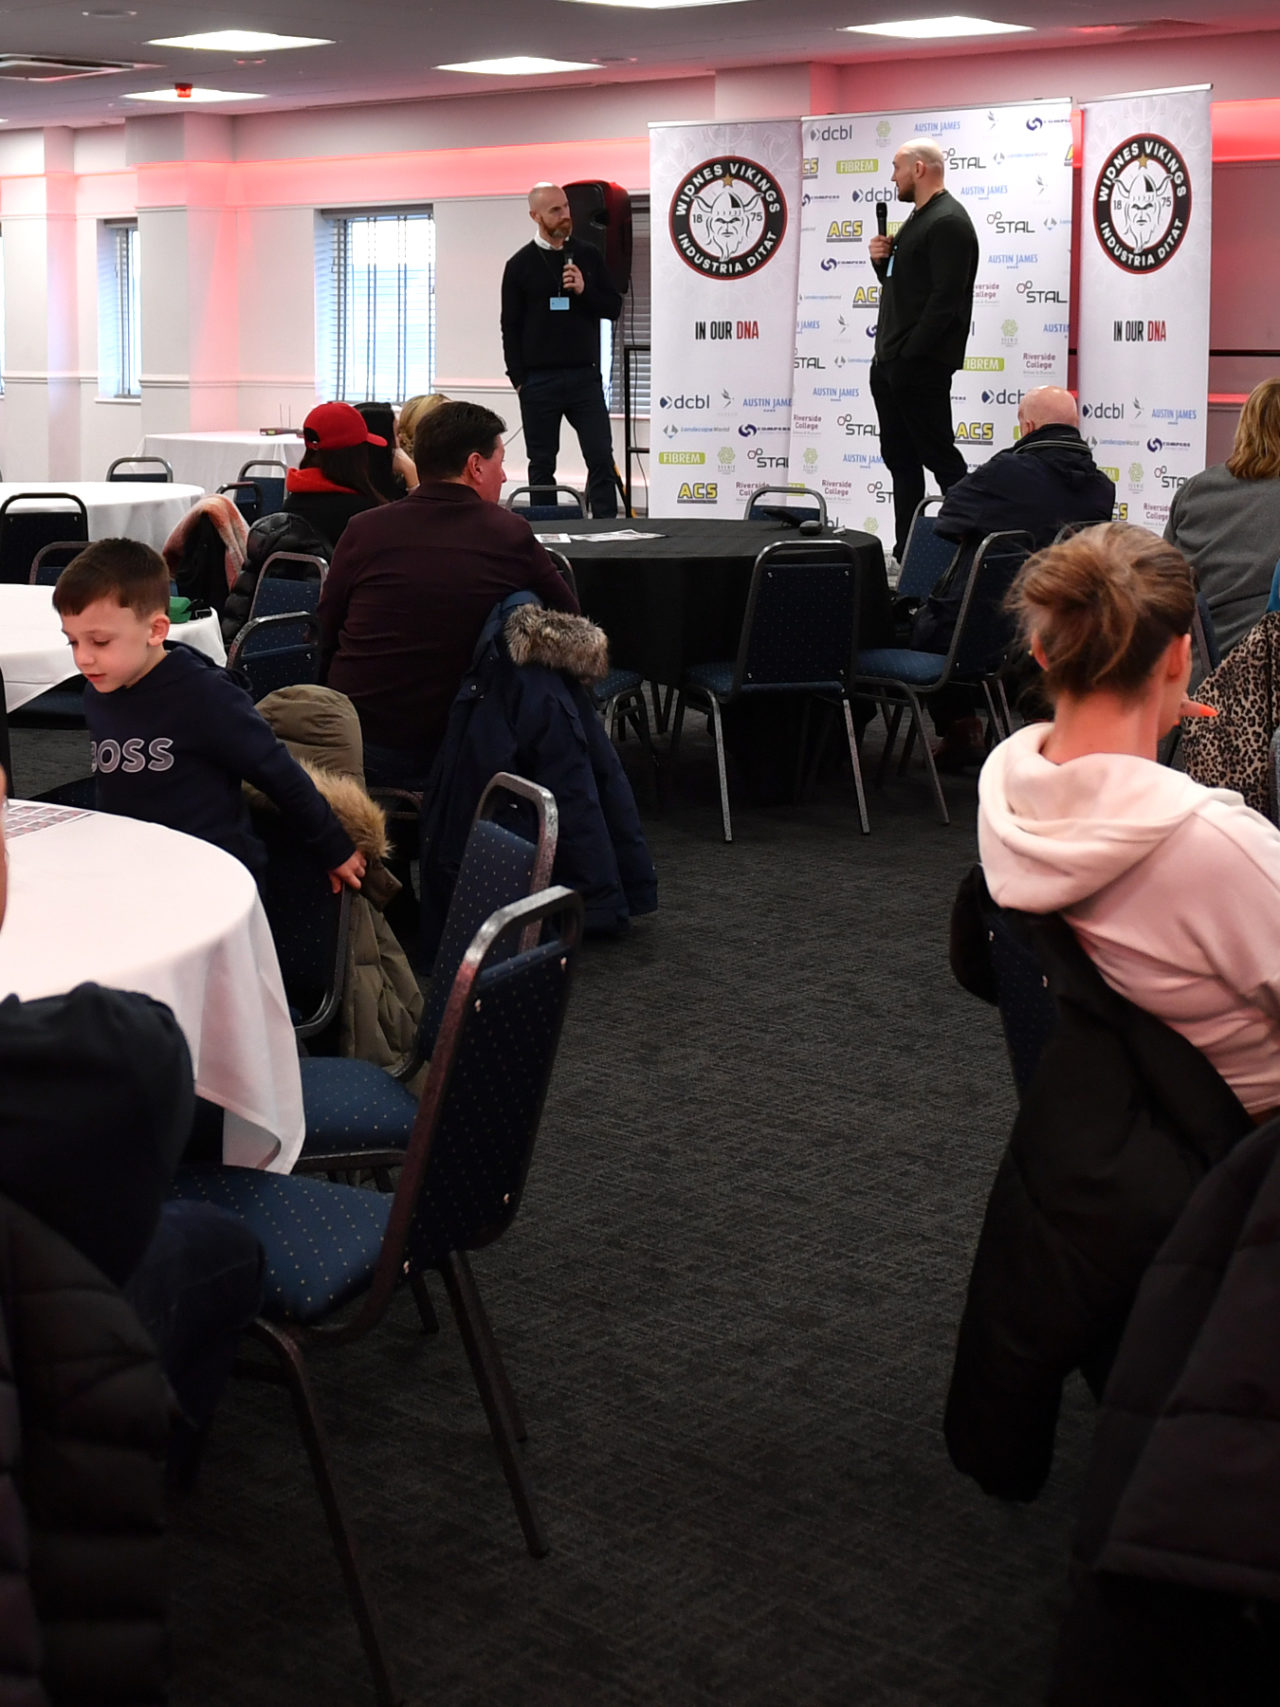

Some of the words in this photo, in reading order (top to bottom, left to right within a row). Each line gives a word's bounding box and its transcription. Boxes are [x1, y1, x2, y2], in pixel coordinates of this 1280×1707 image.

[821, 124, 853, 141] dcbl
[914, 122, 939, 132] AUSTIN
[940, 120, 961, 132] JAMES
[840, 160, 875, 173] FIBREM
[949, 156, 987, 170] STAL
[1098, 143, 1139, 202] WIDNES
[1144, 141, 1187, 197] VIKINGS
[675, 164, 723, 216] WIDNES
[729, 163, 781, 213] VIKINGS
[864, 186, 897, 203] dcbl
[960, 186, 985, 196] AUSTIN
[986, 185, 1008, 196] JAMES
[1113, 199, 1123, 210] 18
[1161, 197, 1172, 207] 75
[692, 213, 703, 223] 18
[750, 211, 763, 222] 75
[827, 220, 863, 238] ACS
[995, 220, 1036, 234] STAL
[1100, 222, 1155, 267] INDUSTRIA
[1158, 218, 1184, 259] DITAT
[677, 232, 744, 274] INDUSTRIA
[746, 230, 778, 268] DITAT
[988, 254, 1014, 264] AUSTIN
[1015, 254, 1038, 265] JAMES
[1026, 290, 1068, 304] STAL
[695, 321, 706, 340] IN
[710, 321, 732, 340] OUR
[736, 321, 759, 340] DNA
[1113, 320, 1123, 341] IN
[1125, 320, 1144, 341] OUR
[1147, 320, 1166, 341] DNA
[1022, 352, 1056, 361] Riverside
[1025, 361, 1053, 370] College
[813, 387, 837, 396] AUSTIN
[838, 387, 860, 399] JAMES
[674, 394, 710, 409] dcbl
[742, 398, 771, 407] AUSTIN
[772, 398, 792, 408] JAME
[1094, 403, 1124, 419] dcbl
[1152, 408, 1174, 418] AUSTIN
[1175, 409, 1197, 420] JAMES
[793, 413, 822, 423] Riverside
[794, 422, 819, 431] College
[955, 422, 995, 440] ACS
[663, 453, 701, 464] FIBREM
[843, 454, 867, 463] AUSTIN
[821, 479, 852, 488] Riverside
[677, 482, 718, 499] ACS
[824, 487, 849, 497] College
[90, 738, 175, 773] OSS
